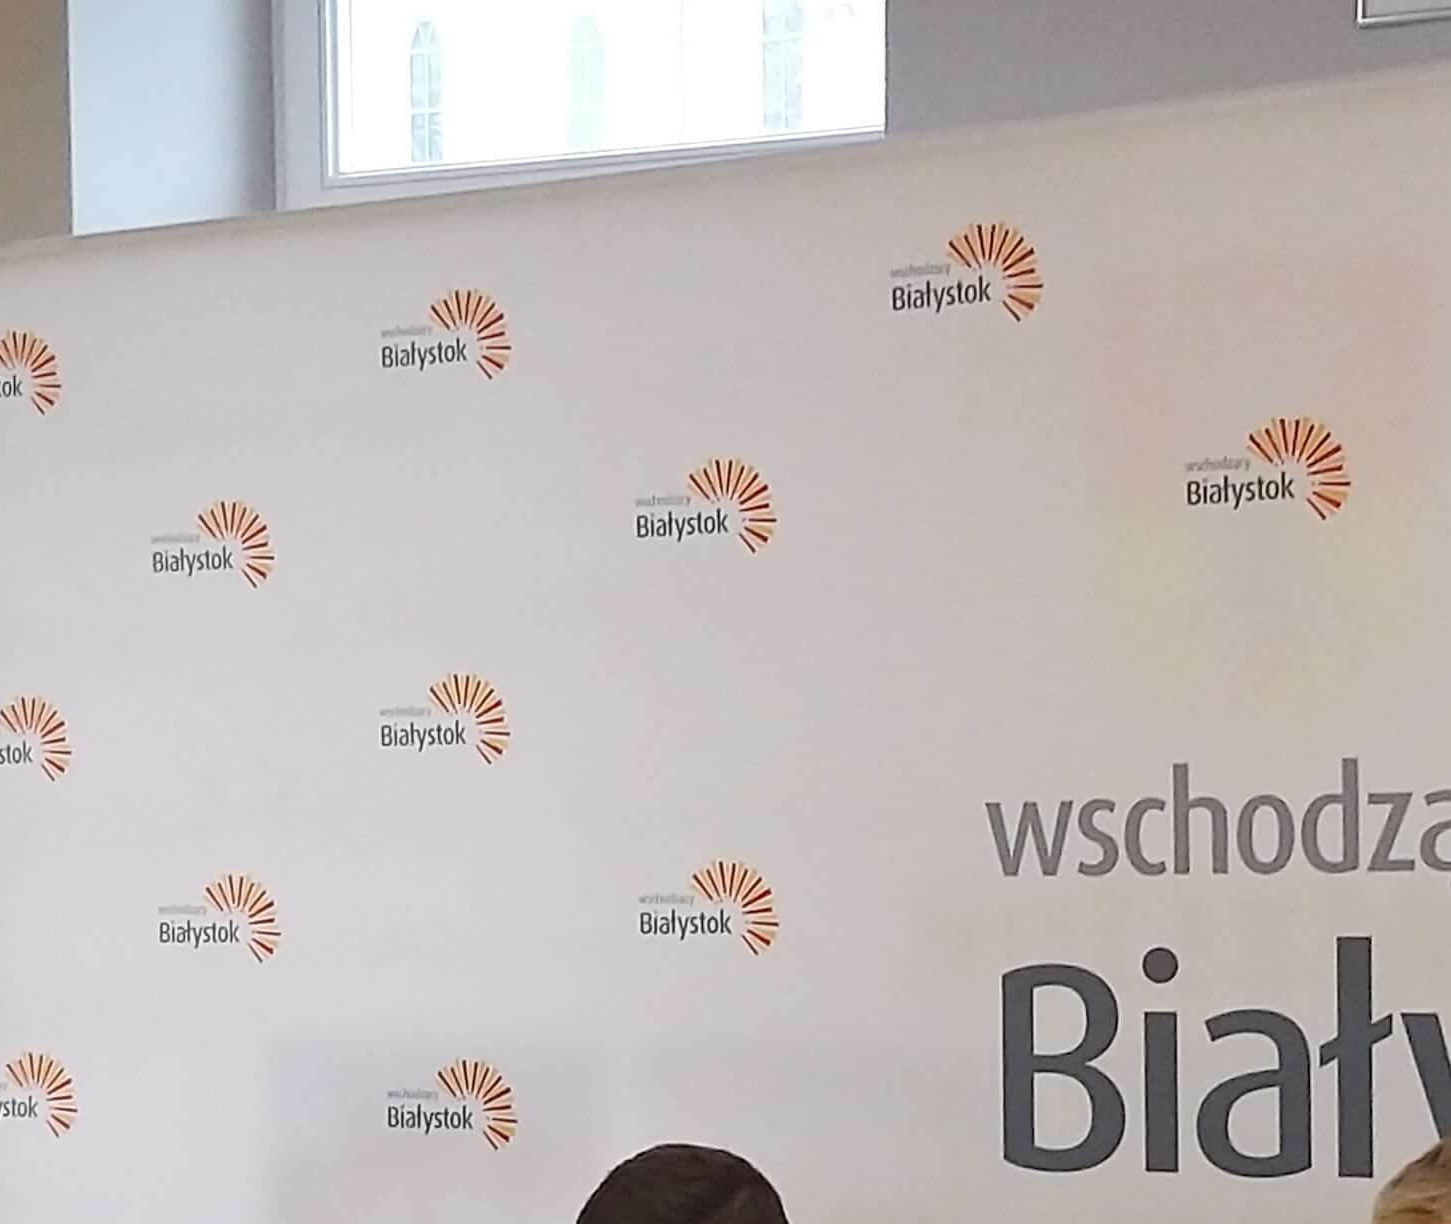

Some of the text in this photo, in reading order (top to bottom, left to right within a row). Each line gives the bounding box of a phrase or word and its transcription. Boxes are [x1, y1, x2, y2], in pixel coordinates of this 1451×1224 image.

[891, 275, 991, 314] Białystok
[381, 337, 467, 372] Białystok
[1186, 471, 1295, 510] Białystok
[636, 508, 728, 542] Białystok
[152, 545, 233, 577] Białystok
[381, 720, 466, 752] Białystok
[159, 920, 240, 949] Białystok
[640, 908, 732, 941] Białystok
[387, 1104, 474, 1135] Białystok
